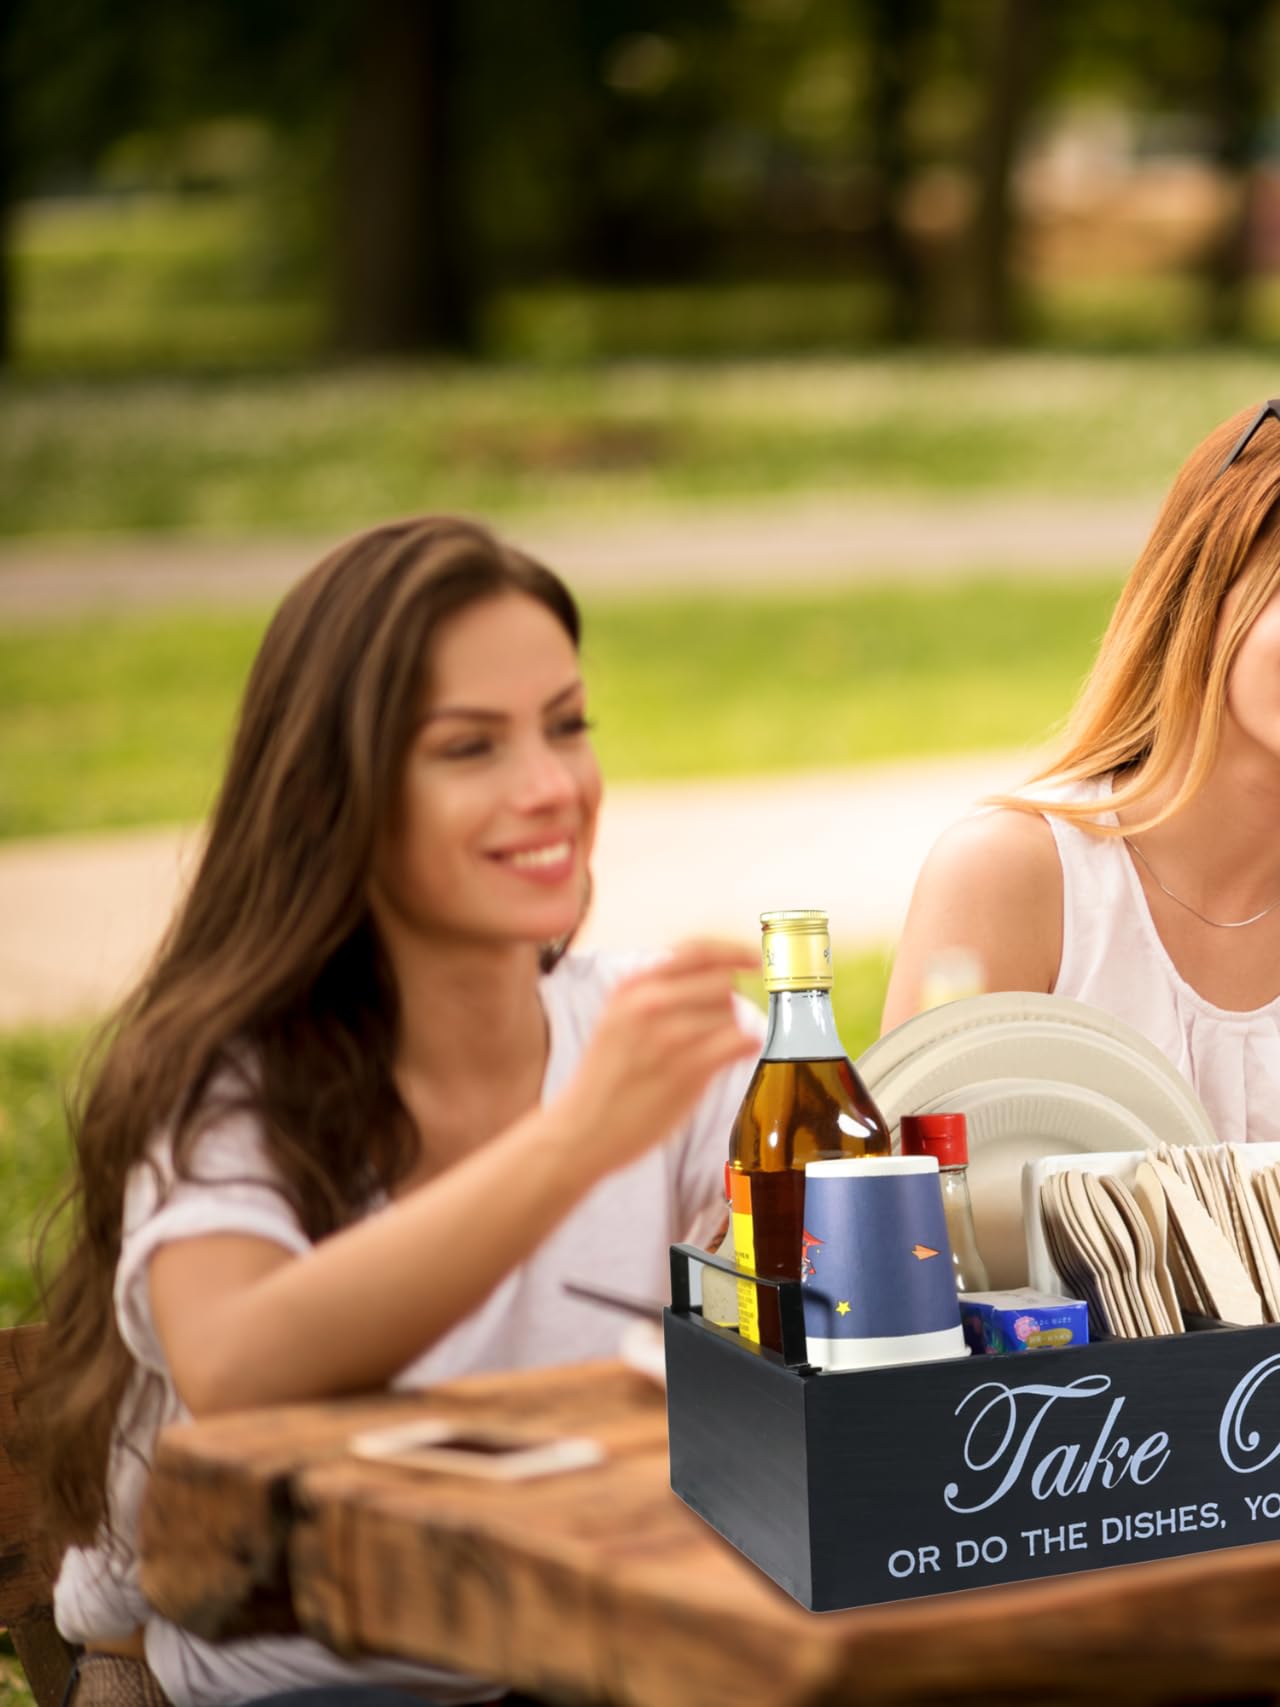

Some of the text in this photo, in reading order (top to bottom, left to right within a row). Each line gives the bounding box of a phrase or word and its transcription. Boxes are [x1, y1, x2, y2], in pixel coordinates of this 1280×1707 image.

[943, 1374, 1171, 1514] Take
[887, 1545, 941, 1578] OR
[956, 1535, 1008, 1568] DO
[1020, 1521, 1088, 1558] THE
[1101, 1502, 1228, 1546] DISHES,
